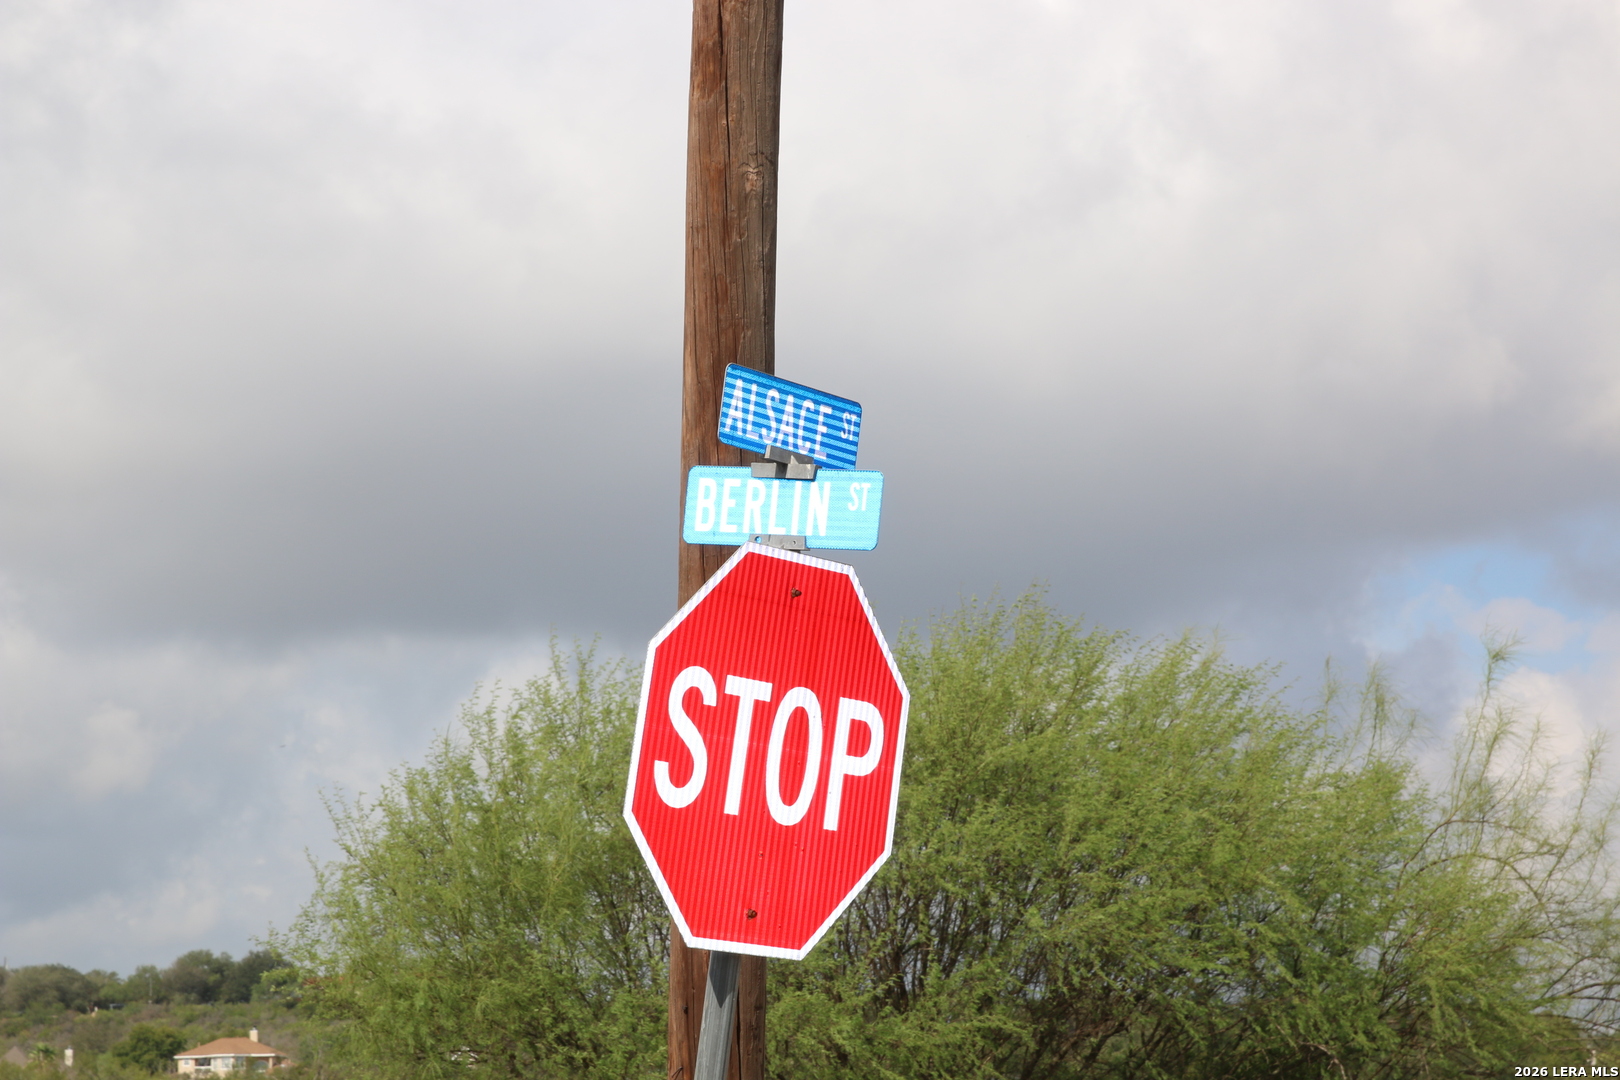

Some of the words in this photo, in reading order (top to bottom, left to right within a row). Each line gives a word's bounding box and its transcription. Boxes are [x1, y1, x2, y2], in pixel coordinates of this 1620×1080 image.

[724, 378, 832, 460] ALSACE
[840, 411, 857, 441] ST
[694, 477, 831, 537] BERLIN
[847, 482, 871, 511] ST
[653, 665, 885, 832] STOP
